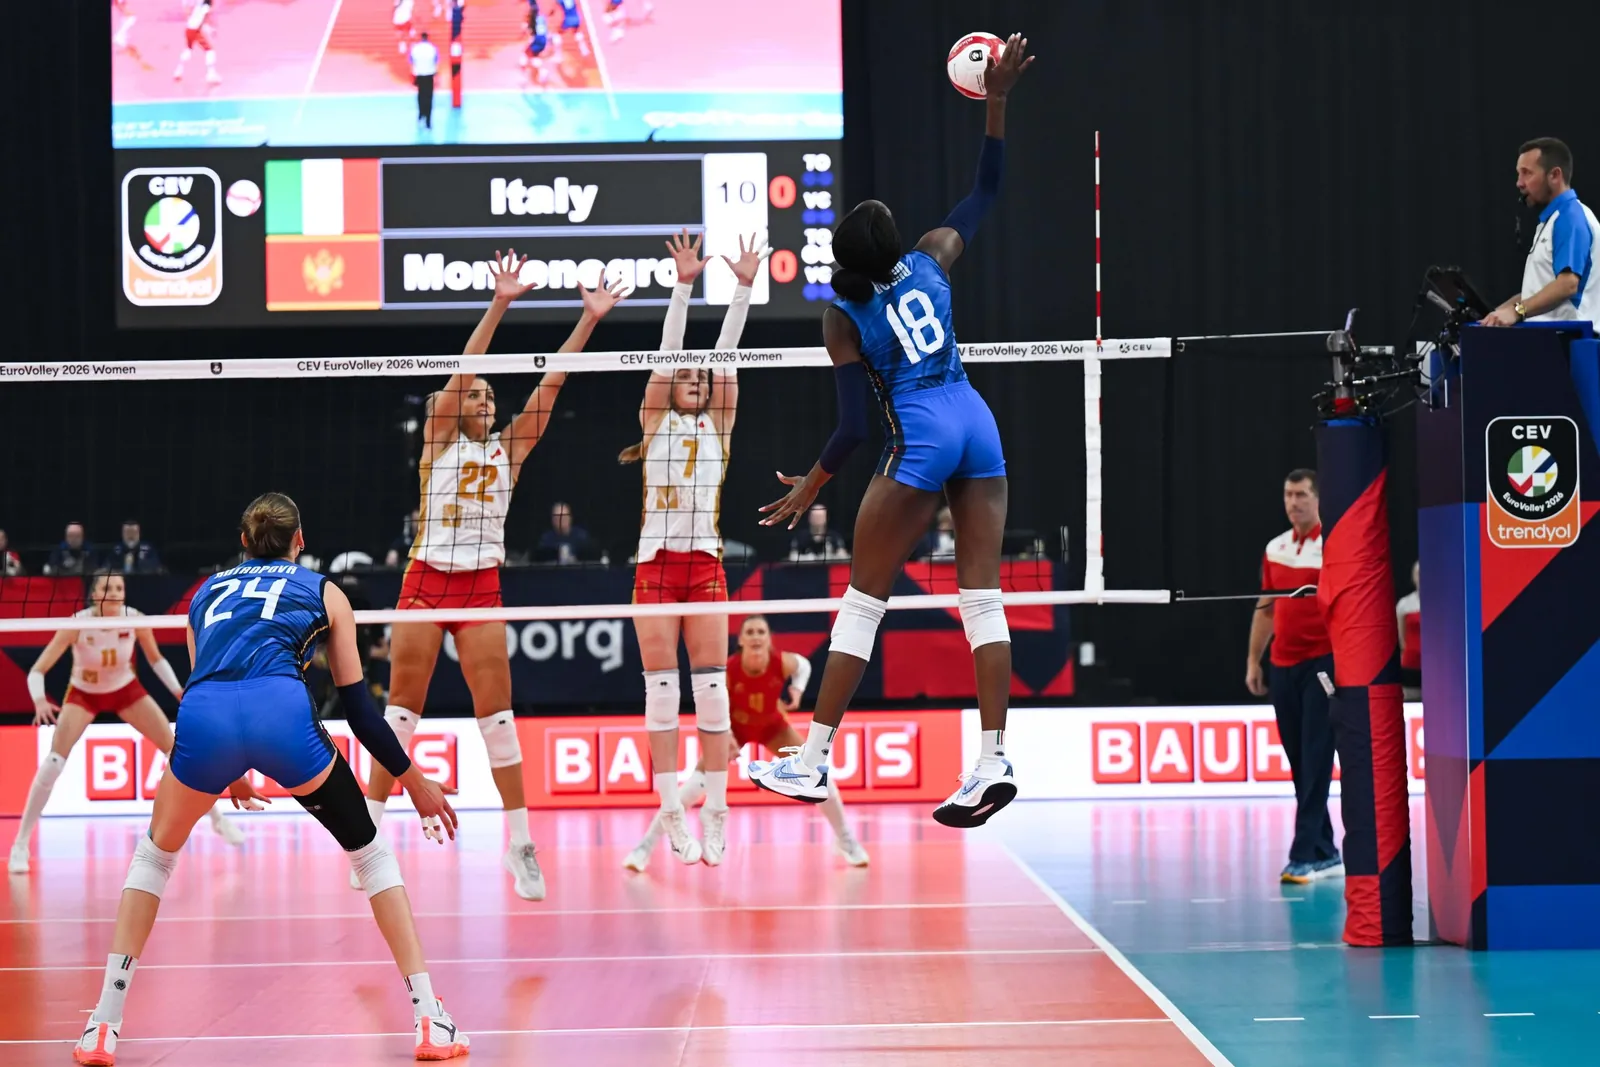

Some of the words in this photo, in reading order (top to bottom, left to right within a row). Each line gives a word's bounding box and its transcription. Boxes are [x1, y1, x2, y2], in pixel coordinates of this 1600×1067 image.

[149, 176, 194, 195] CEV
[717, 181, 756, 204] 10
[769, 175, 796, 208] 0
[490, 177, 598, 222] Italy
[770, 250, 798, 283] 0
[886, 289, 945, 364] 18
[620, 354, 644, 364] CEV
[647, 353, 706, 364] EuroVolley
[709, 352, 736, 362] 2026
[739, 351, 782, 362] Women
[969, 346, 1028, 357] EuroVolley
[1031, 345, 1058, 355] 2026
[1061, 344, 1103, 354] Won
[0, 365, 59, 377] EuroVolley
[62, 364, 90, 375] 2026
[92, 364, 136, 374] Women
[297, 361, 321, 371] CEV
[324, 360, 383, 372] EuroVolley
[386, 359, 414, 369] 2026
[417, 358, 460, 369] Women
[1511, 425, 1552, 439] CEV
[683, 440, 699, 479] 7
[458, 461, 498, 502] 22
[1502, 492, 1545, 512] EuroVolley
[1545, 491, 1564, 509] 2026
[1498, 523, 1571, 541] trendyol
[204, 577, 288, 629] 24
[102, 648, 117, 667] 11
